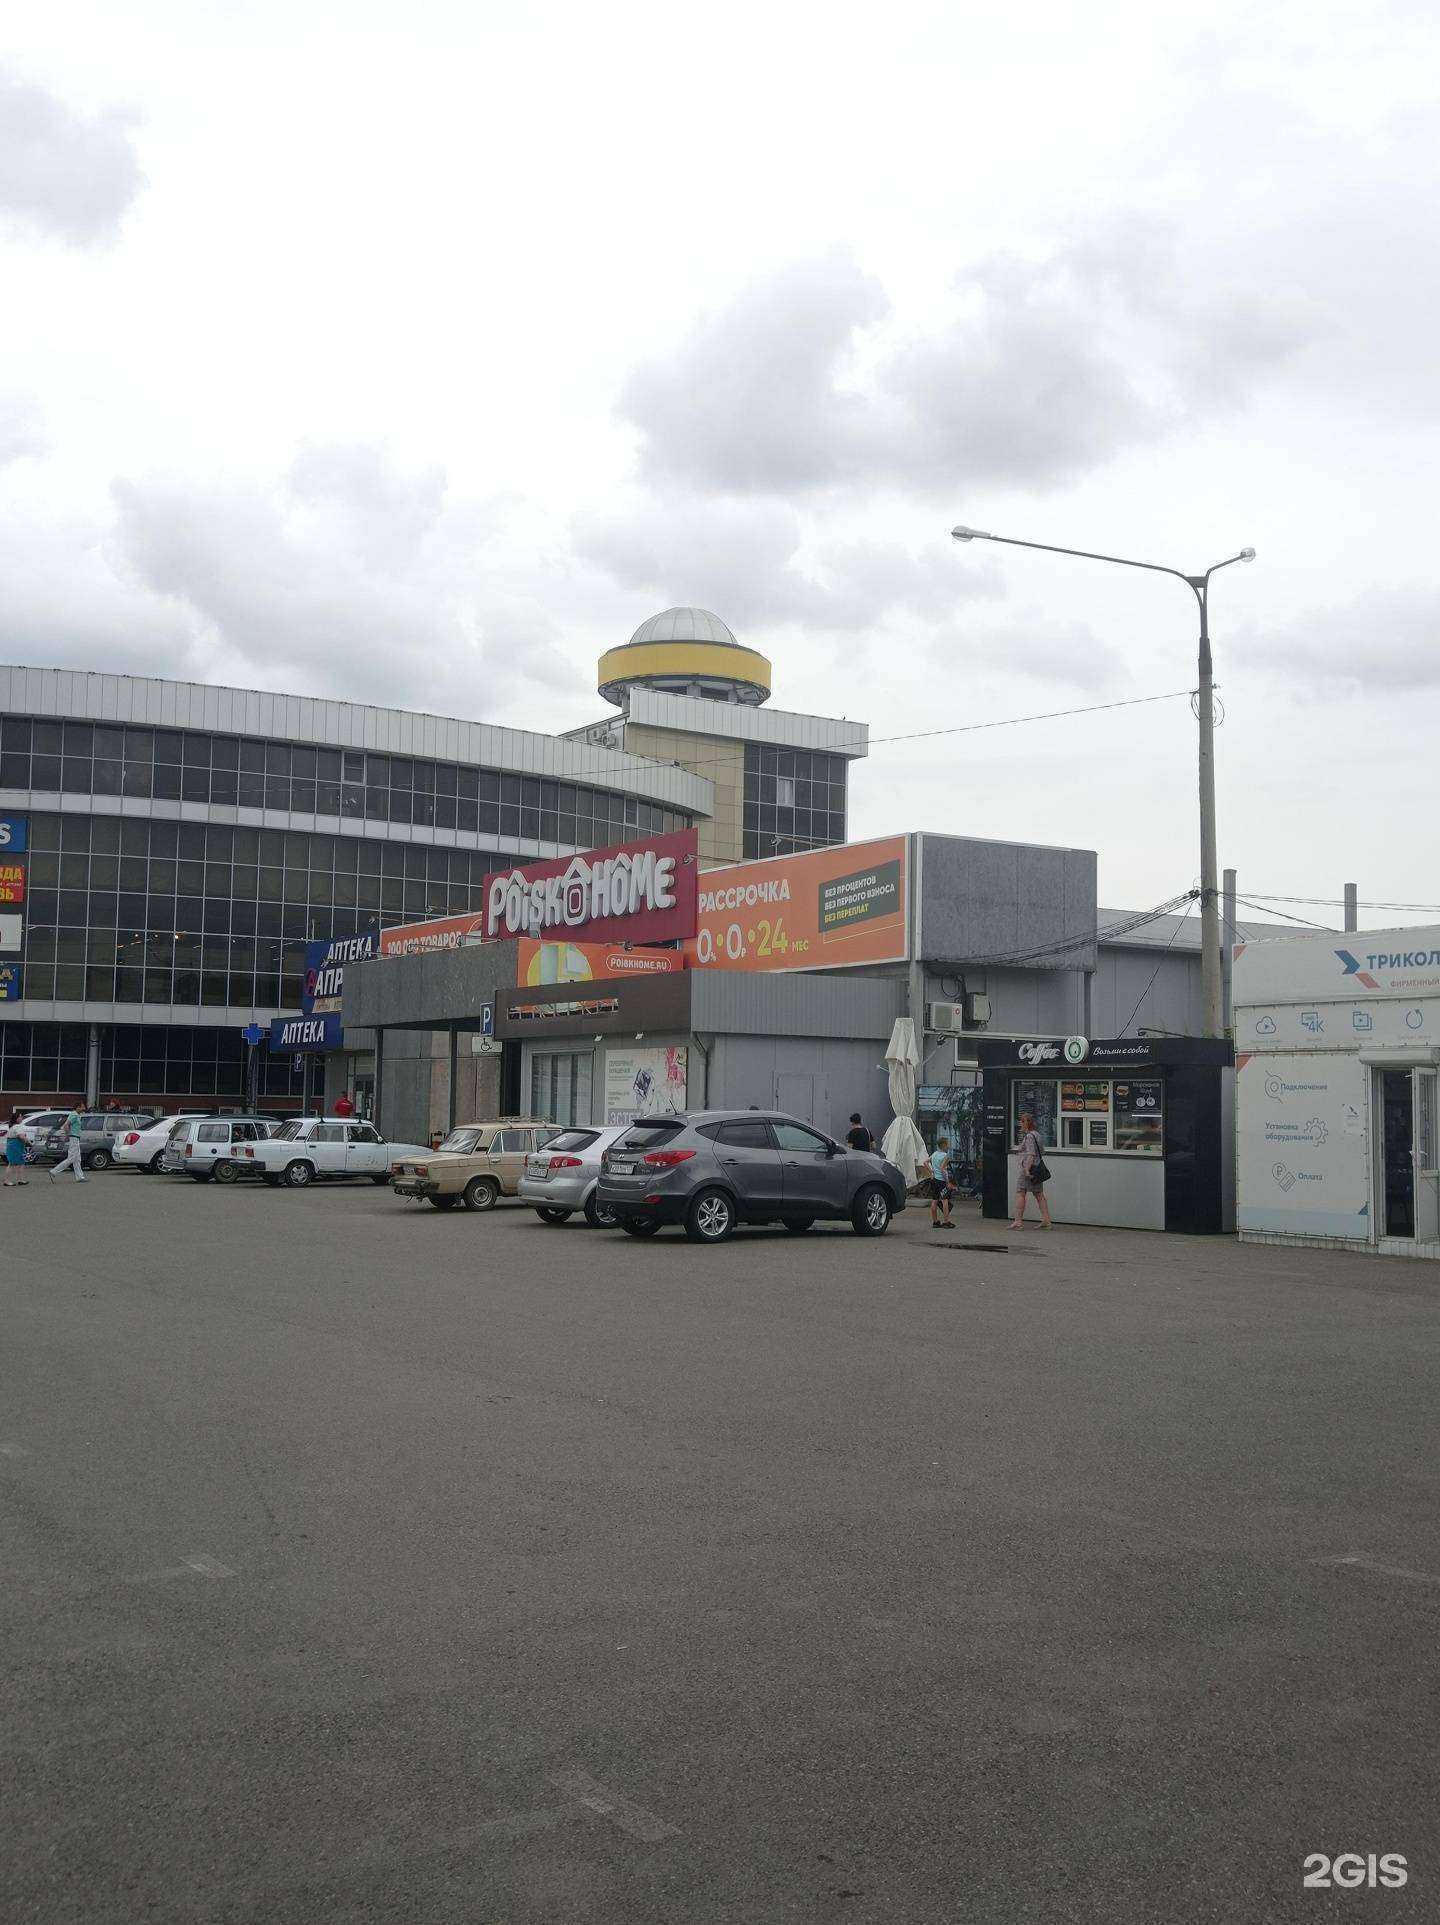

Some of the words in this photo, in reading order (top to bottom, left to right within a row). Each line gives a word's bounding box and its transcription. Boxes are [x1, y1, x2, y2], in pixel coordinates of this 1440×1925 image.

[698, 878, 792, 914] РАССРОЧКА
[825, 887, 837, 898] БЕЗ
[837, 875, 876, 894] ПРОЦЕНТОВ
[825, 900, 837, 911] БЕЗ
[837, 891, 867, 907] ПЕРВОГО
[867, 883, 895, 899] ВЗНОСА
[825, 912, 837, 924] БЕЗ
[837, 902, 869, 919] ПЕРЕПЛАТ
[756, 917, 788, 957] 24
[326, 936, 373, 962] АПТЕКА
[1366, 950, 1440, 970] ТРИКОЛ
[281, 1020, 325, 1044] АПТЕКА
[1280, 1083, 1329, 1092] Подключение
[1264, 1122, 1299, 1132] Установка
[1265, 1132, 1315, 1143] оборудования
[1298, 1172, 1324, 1182] Оплата
